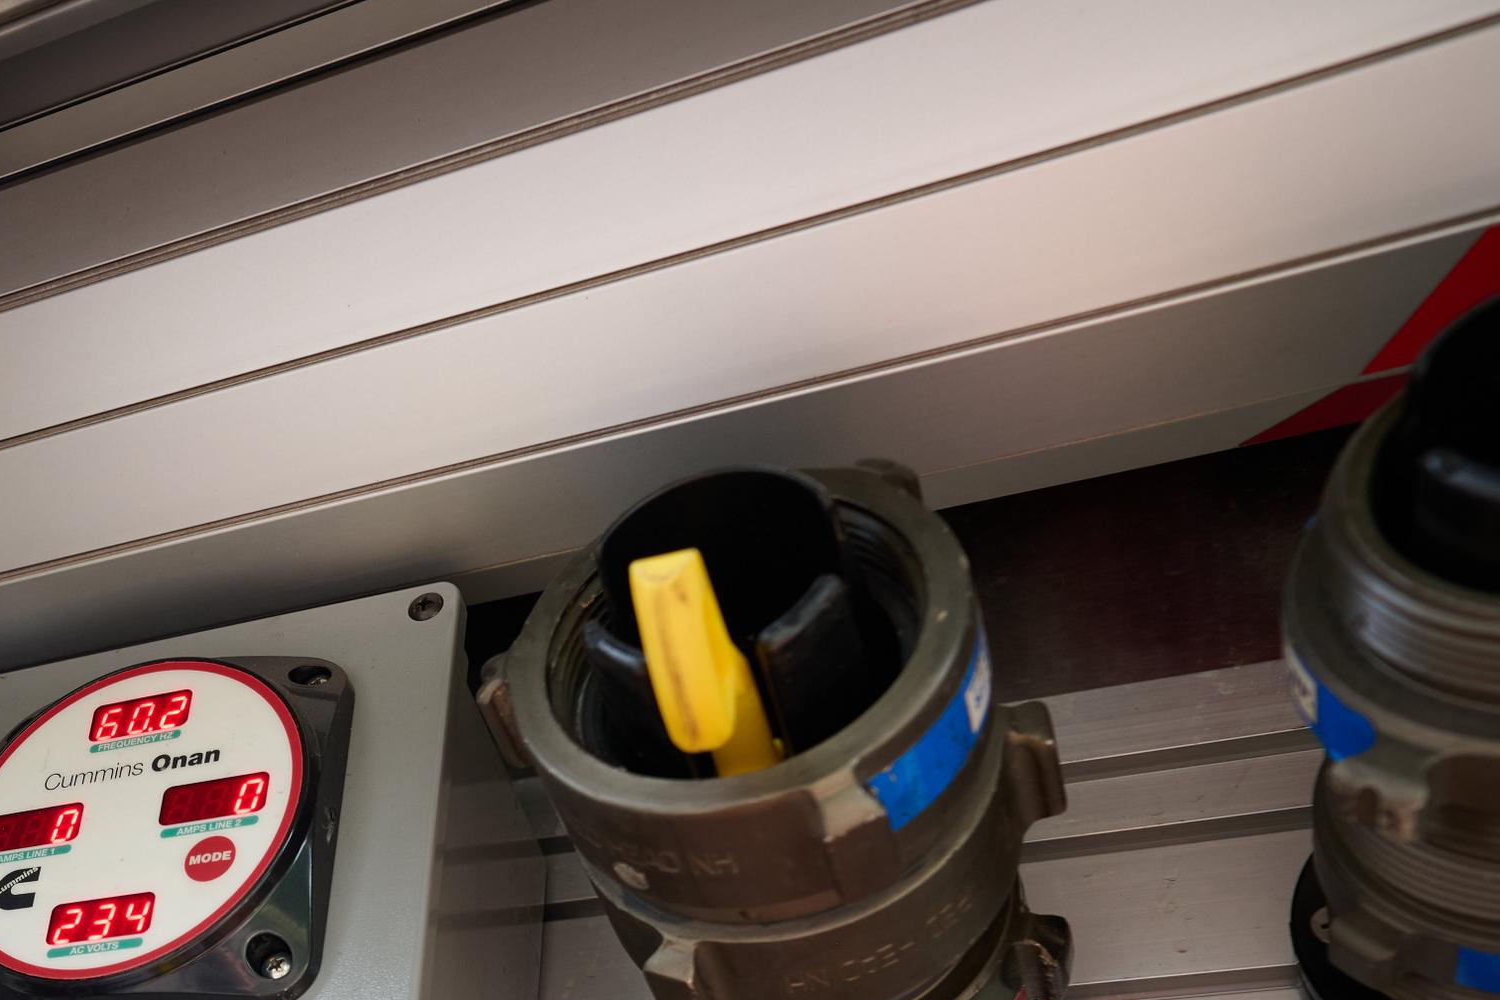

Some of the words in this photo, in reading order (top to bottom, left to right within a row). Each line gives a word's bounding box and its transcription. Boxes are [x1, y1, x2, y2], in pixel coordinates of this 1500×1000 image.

[96, 696, 188, 740] 60.2
[98, 734, 157, 752] FREQUENCY
[159, 731, 174, 741] HZ
[44, 761, 144, 791] Cummins
[151, 748, 221, 773] Onan
[234, 778, 264, 814] 0
[50, 809, 79, 843] 0
[176, 825, 207, 836] AMPS
[208, 820, 233, 831] LINE
[235, 819, 242, 827] 2
[26, 848, 48, 859] LINE
[188, 850, 232, 866] MODE
[53, 901, 151, 944] 234
[69, 946, 85, 956] AC
[87, 941, 120, 953] VOLTS
